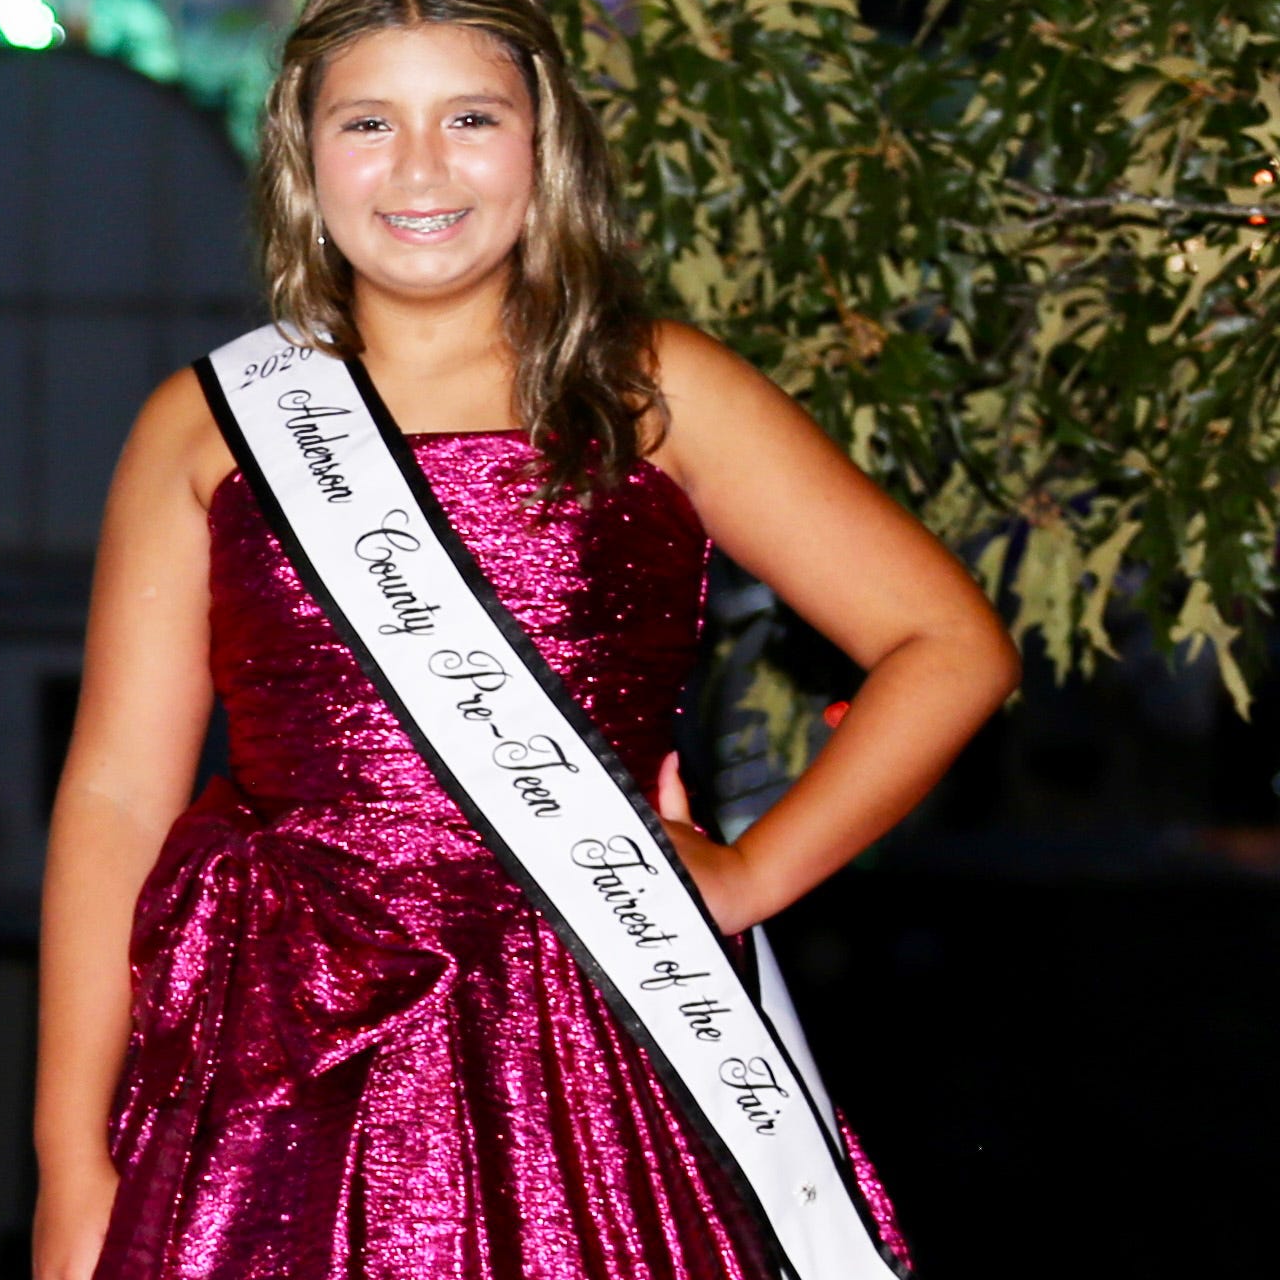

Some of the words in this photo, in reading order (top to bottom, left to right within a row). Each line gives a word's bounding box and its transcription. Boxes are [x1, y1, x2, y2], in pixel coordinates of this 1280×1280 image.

[277, 389, 352, 504] Anderson
[354, 509, 441, 637] County
[571, 834, 678, 950] Fairest
[639, 953, 711, 992] of
[678, 979, 730, 1043] the
[719, 1055, 789, 1137] Fair
